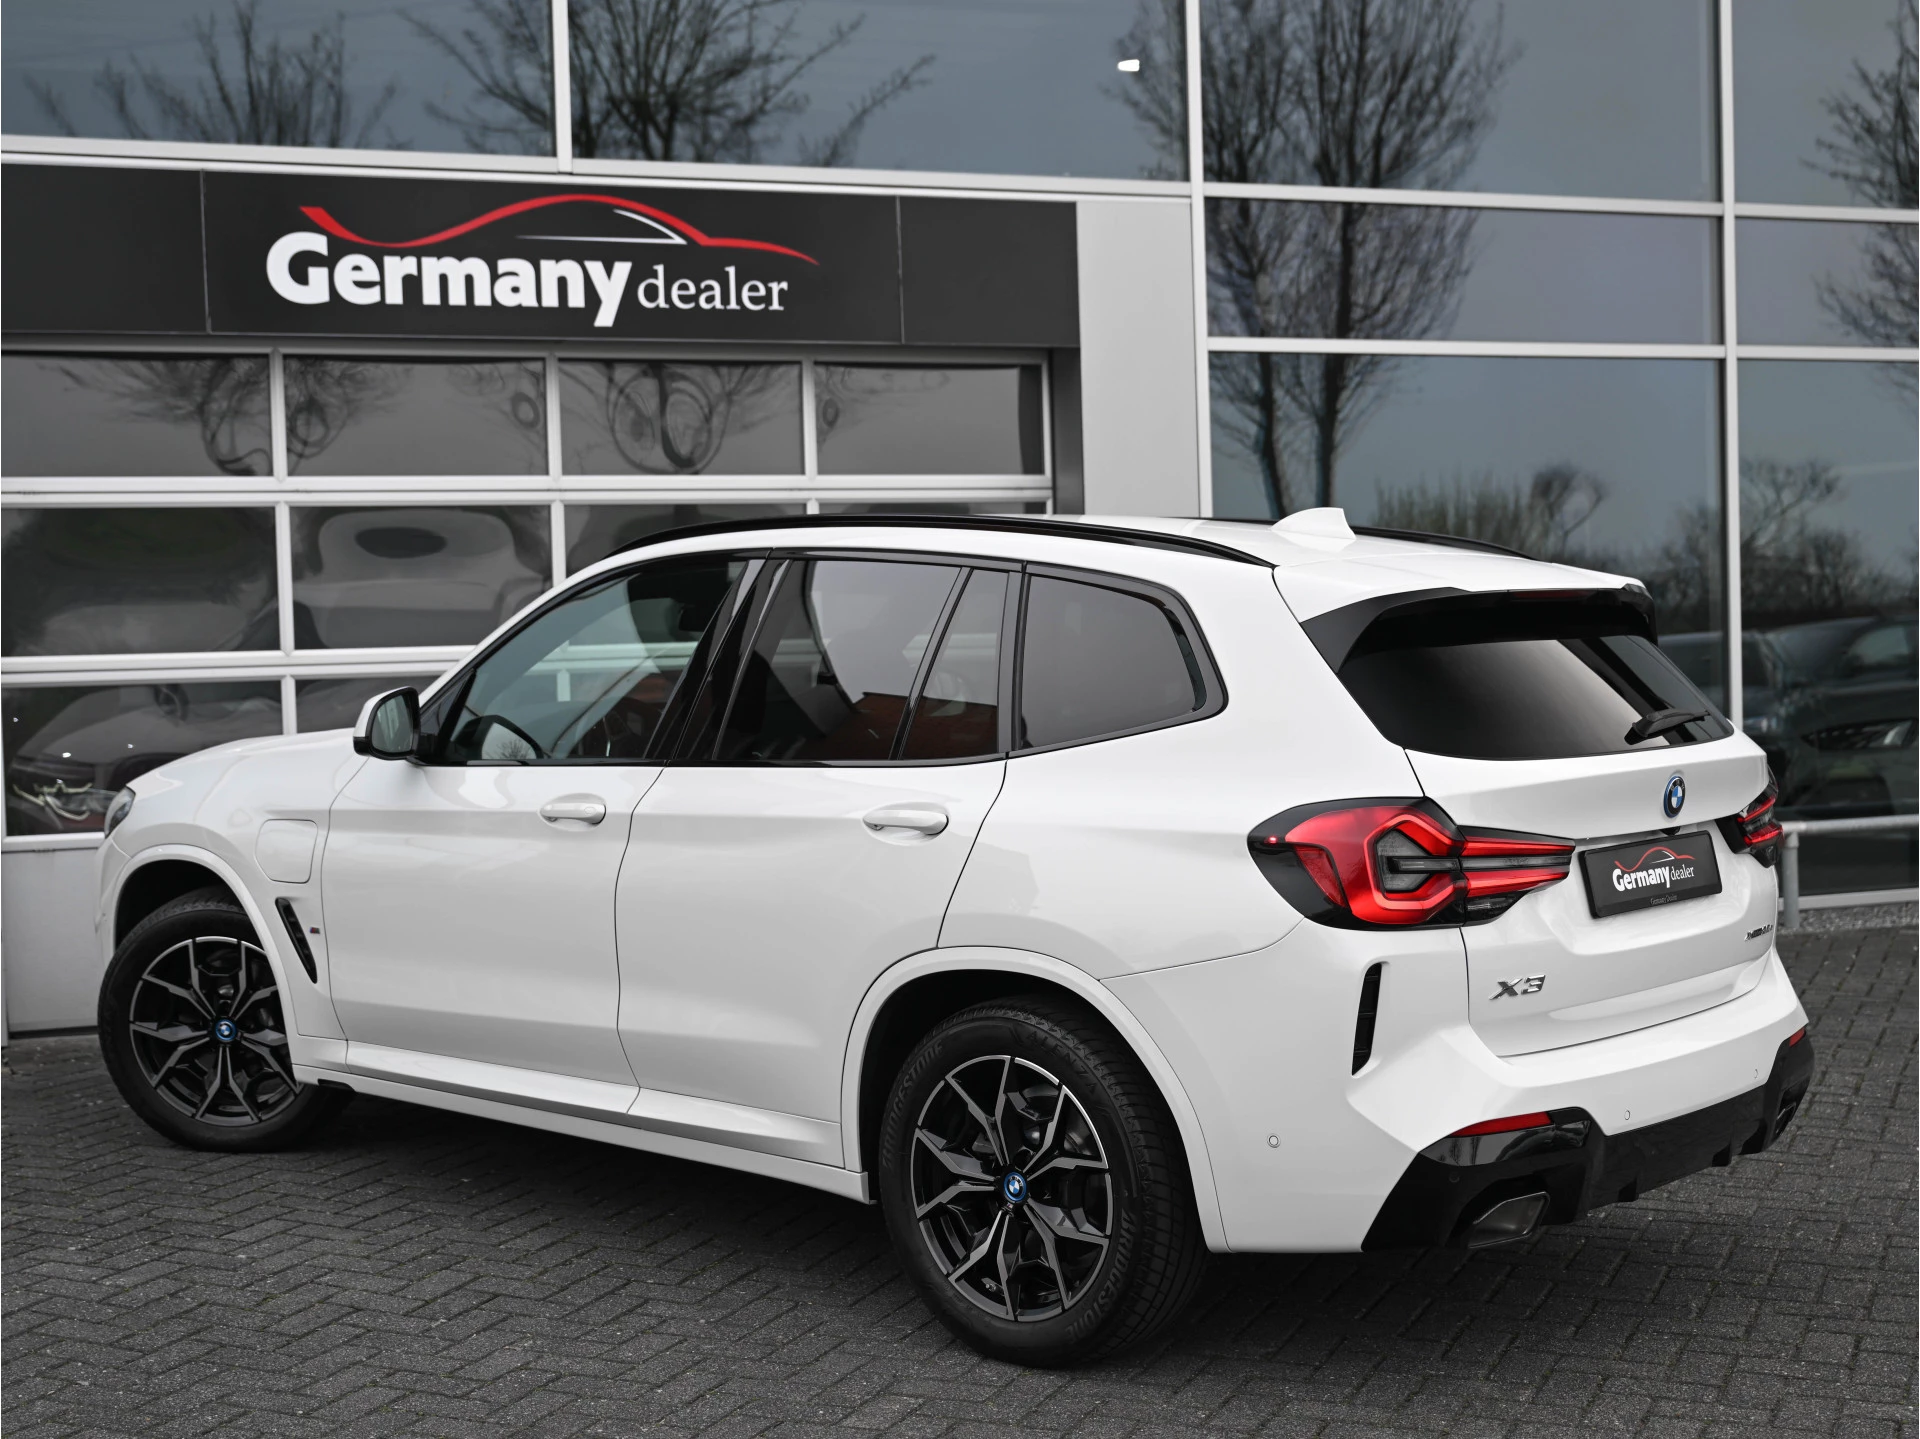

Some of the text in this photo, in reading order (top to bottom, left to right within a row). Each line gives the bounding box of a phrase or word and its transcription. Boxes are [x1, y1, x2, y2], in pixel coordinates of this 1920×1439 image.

[266, 231, 789, 327] Germany dealer
[1612, 864, 1695, 892] Germany dealer
[1488, 974, 1547, 1001] X3
